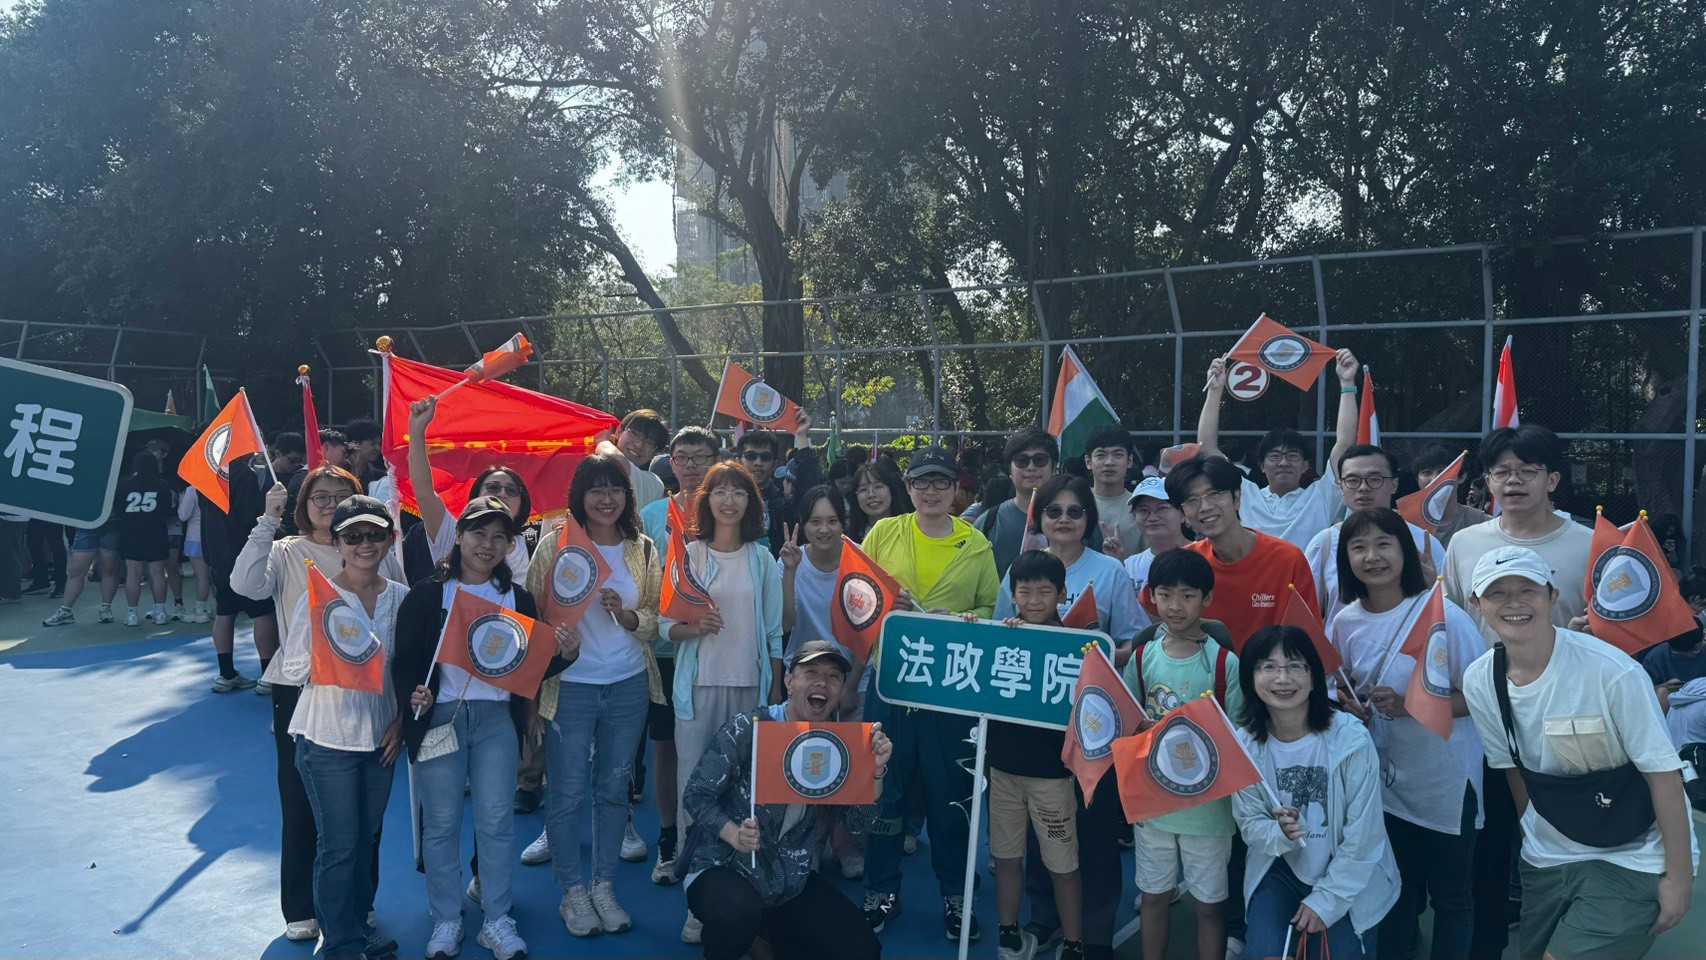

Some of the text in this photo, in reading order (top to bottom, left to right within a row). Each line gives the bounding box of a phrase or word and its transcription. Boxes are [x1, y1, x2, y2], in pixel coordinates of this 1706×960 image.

[1232, 365, 1262, 392] 2
[3, 403, 83, 486] 程
[125, 491, 158, 513] 25
[897, 634, 1083, 705] 法政學院
[1306, 829, 1329, 839] land
